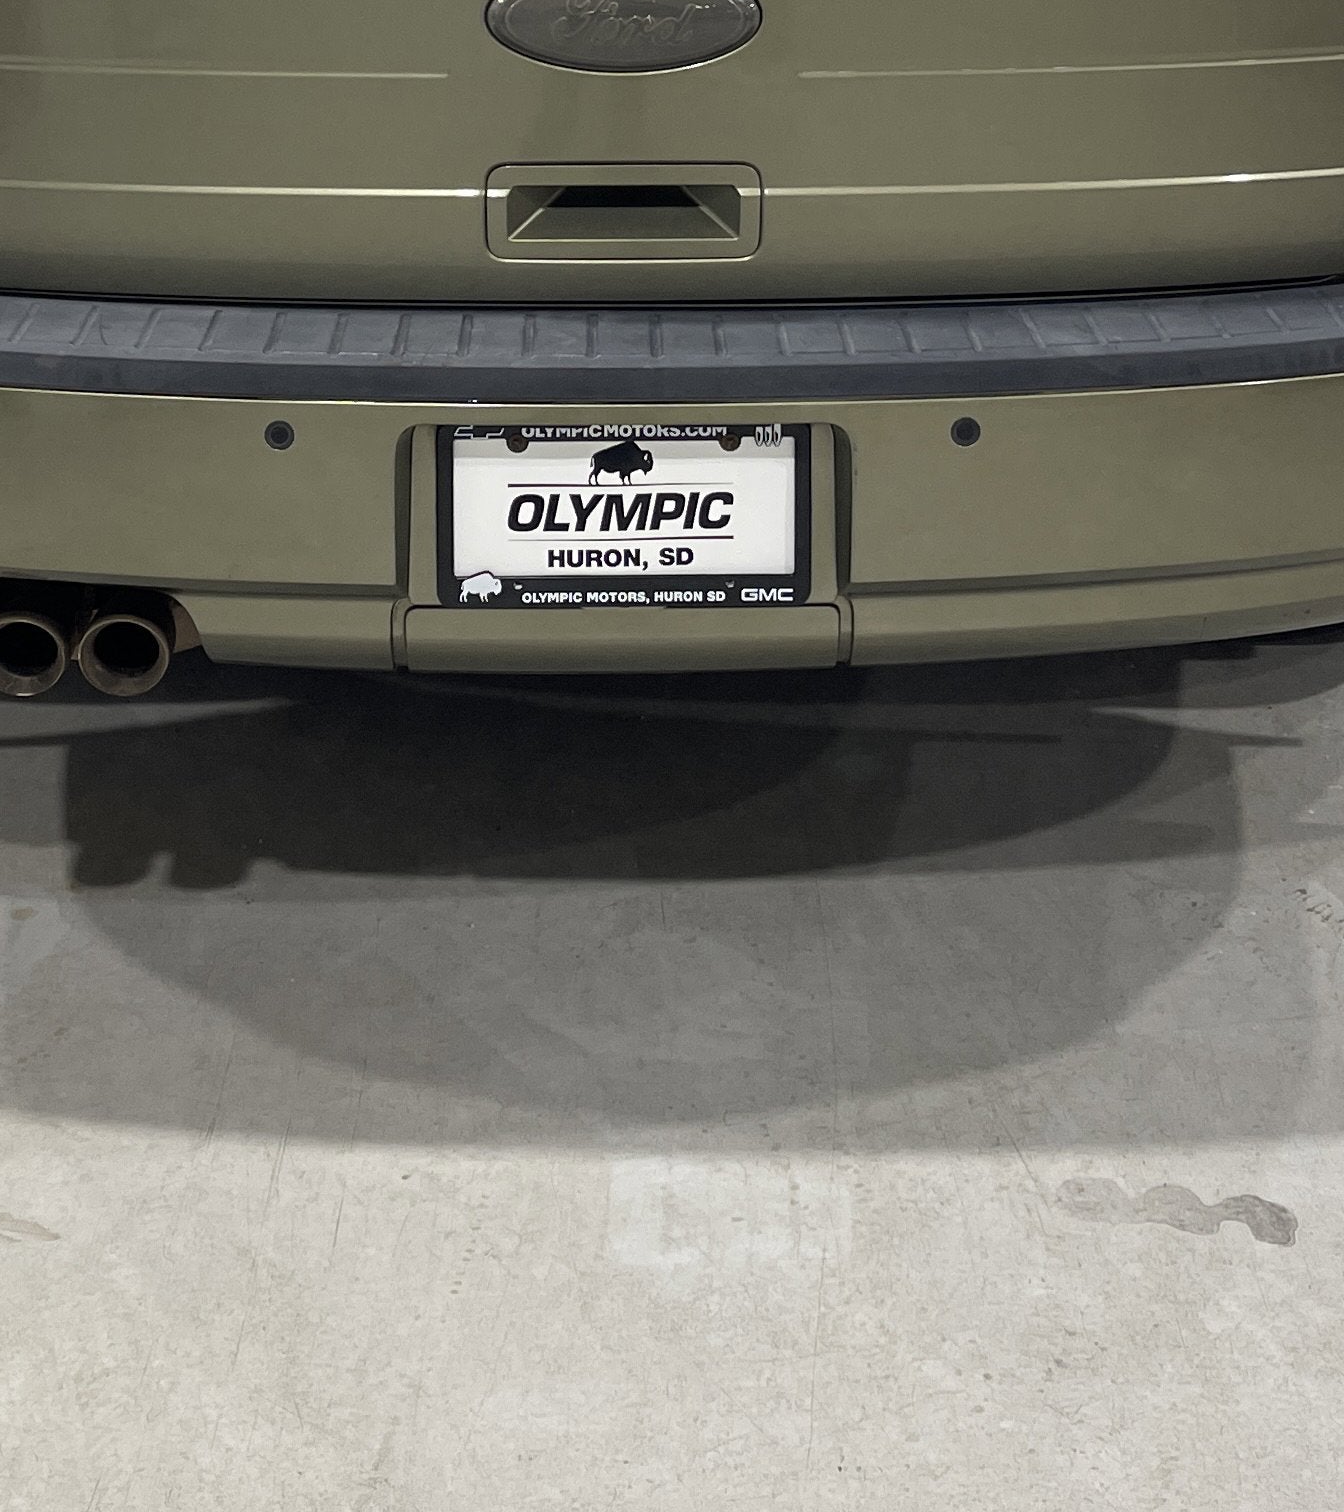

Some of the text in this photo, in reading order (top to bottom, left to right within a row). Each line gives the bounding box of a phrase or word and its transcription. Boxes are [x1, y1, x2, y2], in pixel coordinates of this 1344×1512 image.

[508, 491, 734, 532] OLYMPIC
[547, 547, 694, 571] HURON, SD
[522, 588, 793, 604] OLYMPIC MOTORS, HURON SD GMC
